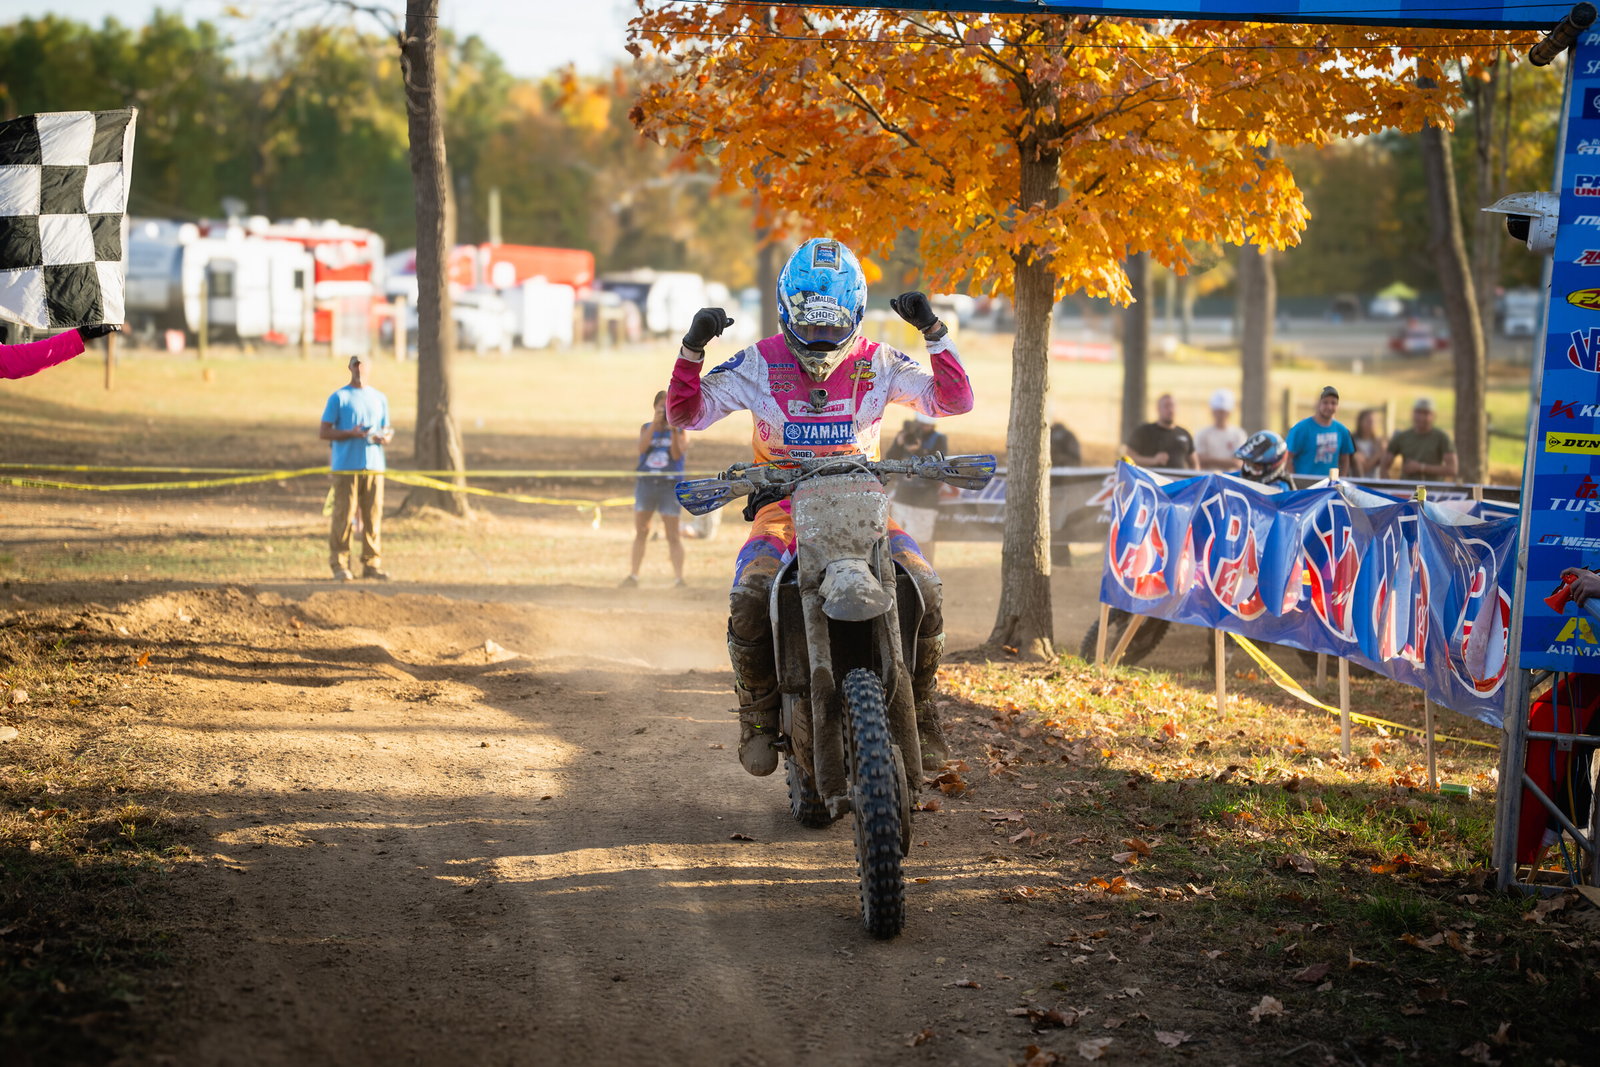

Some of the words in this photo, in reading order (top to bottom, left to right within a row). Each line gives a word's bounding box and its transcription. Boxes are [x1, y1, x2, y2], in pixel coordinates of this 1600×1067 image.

[809, 311, 836, 321] SHOEI
[802, 423, 856, 440] YAMAHA
[791, 449, 813, 458] SHOEI
